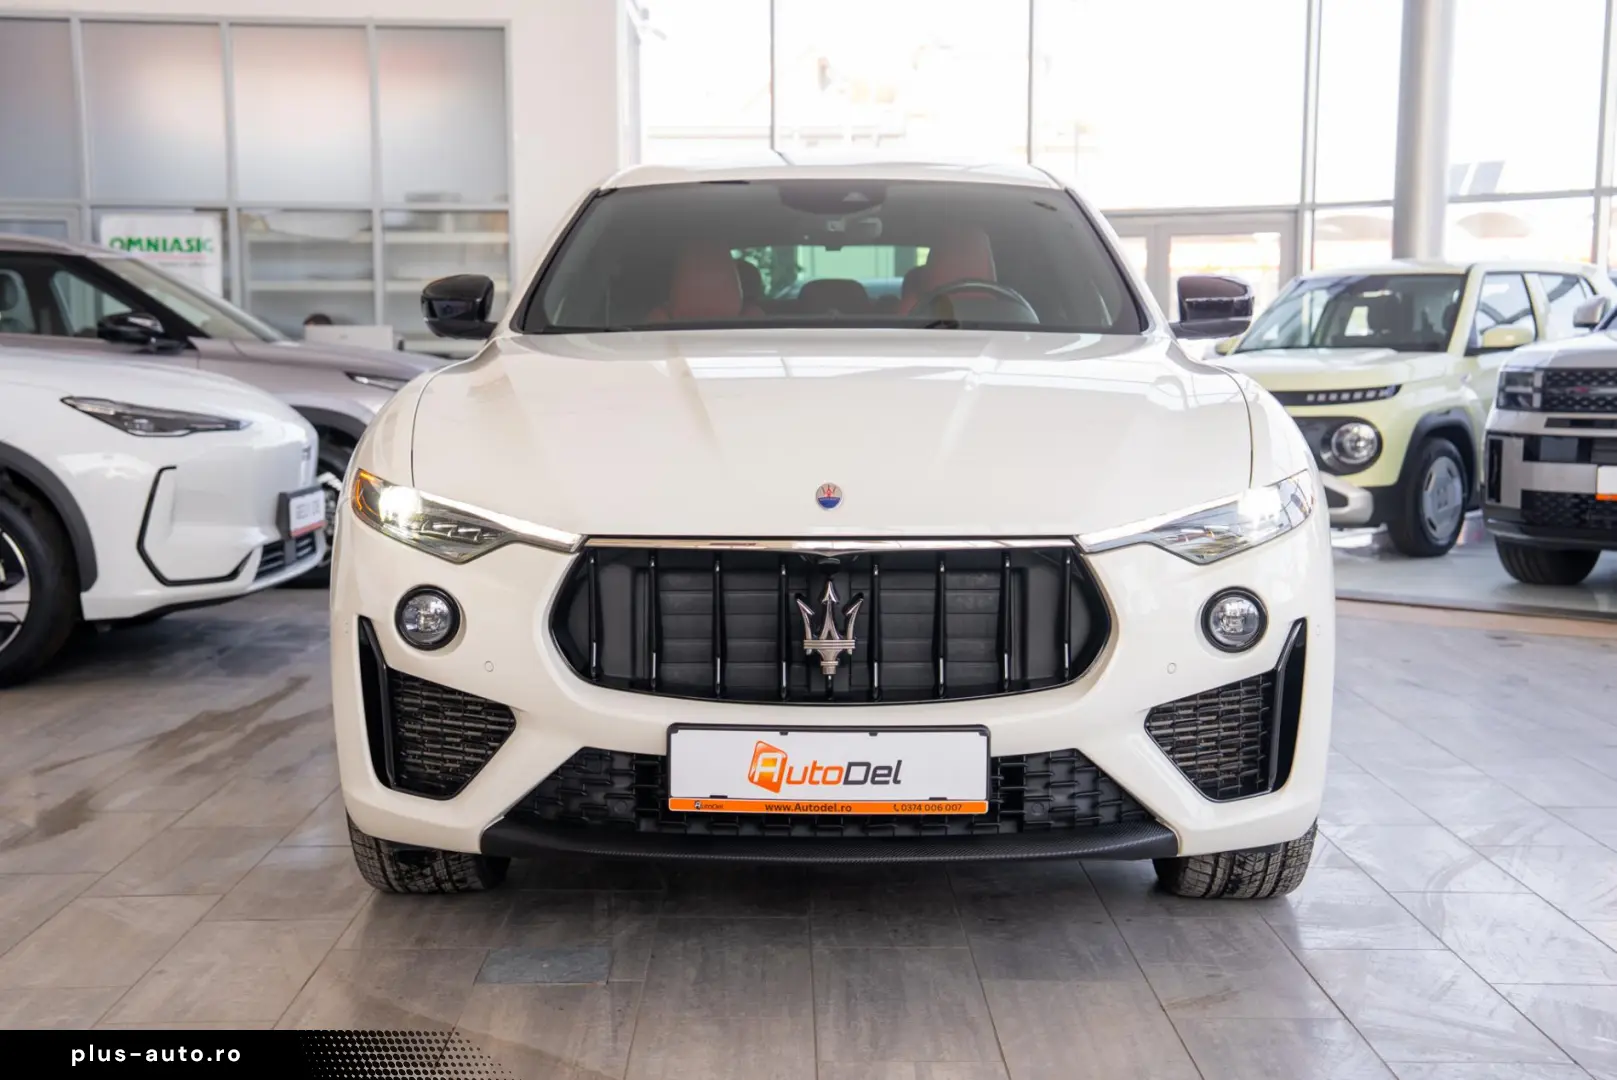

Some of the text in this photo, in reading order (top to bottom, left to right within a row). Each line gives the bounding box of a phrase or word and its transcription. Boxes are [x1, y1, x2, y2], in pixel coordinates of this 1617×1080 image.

[751, 750, 902, 786] AutoDel
[765, 803, 852, 813] www.Autodel.ro
[901, 804, 962, 812] 0374 006 007
